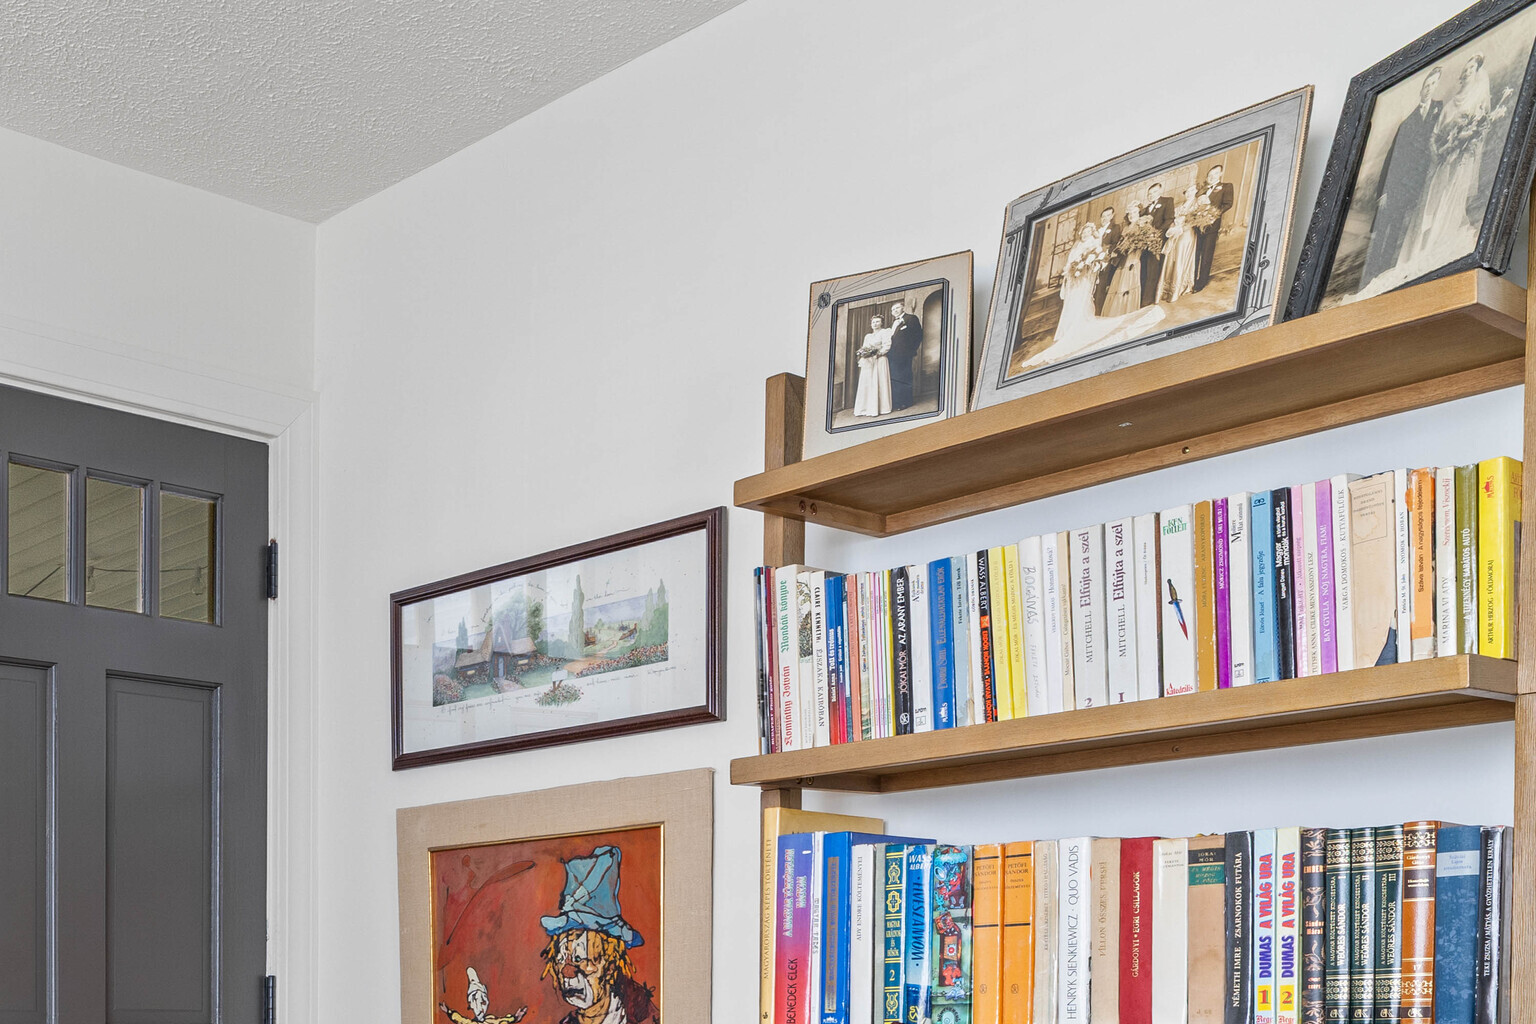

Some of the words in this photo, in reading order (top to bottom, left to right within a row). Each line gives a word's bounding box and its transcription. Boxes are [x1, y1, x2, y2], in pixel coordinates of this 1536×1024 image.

[1441, 477, 1451, 507] Viszockij
[1078, 532, 1090, 554] szél
[1111, 523, 1123, 546] szél
[1319, 524, 1327, 545] FIAM!
[1083, 556, 1090, 564] a
[1275, 542, 1284, 567] Magyar
[1281, 536, 1290, 566] mondák
[1340, 548, 1348, 584] DOMOKOS
[896, 577, 905, 603] EMBER
[1079, 567, 1092, 608] Elfújta
[1112, 560, 1126, 601] Elfújta
[979, 582, 988, 610] ALBERT
[897, 605, 906, 631] ARANY
[1322, 601, 1330, 626] GYULA
[1442, 608, 1450, 644] MARINA
[897, 633, 906, 645] AZ
[1085, 611, 1093, 662] MITCHELL
[1117, 604, 1126, 657] MITCHELL
[1323, 629, 1331, 642] BAY
[898, 650, 907, 668] MÓR
[899, 669, 908, 694] JÓKAI
[1084, 697, 1092, 707] 2
[1069, 845, 1078, 876] VADIS
[1233, 852, 1242, 884] FUTÁRA
[1259, 852, 1272, 880] URA
[1282, 851, 1295, 879] URA
[1132, 871, 1140, 913] CSILLAGOK
[1388, 873, 1396, 881] III
[1068, 880, 1079, 905] QUO
[1256, 881, 1272, 918] VILÁG
[1278, 881, 1295, 917] VILÁG
[1132, 916, 1140, 933] EGRI
[1234, 886, 1242, 938] ZSARNOKOK
[1259, 919, 1272, 929] A
[1282, 918, 1295, 928] A
[1336, 903, 1345, 935] SÁNDOR
[1360, 903, 1369, 934] SÁNDOR
[1386, 901, 1396, 933] SÁNDOR
[1067, 914, 1078, 977] SIENKIEWICZ
[1131, 940, 1139, 977] GÁRDONYI
[1233, 947, 1241, 969] IMRE
[1259, 935, 1272, 978] DUMAS
[1281, 935, 1294, 978] DUMAS
[1337, 935, 1345, 966] WEÖRES
[1361, 934, 1369, 966] WEÖRES
[1387, 934, 1395, 965] WEÖRES
[788, 959, 798, 980] ELEK
[889, 969, 895, 982] 2
[786, 983, 797, 1024] BENEDEK
[1067, 979, 1077, 1019] HENRYK
[1232, 972, 1240, 1007] NÉMETH
[1260, 989, 1269, 1004] 1
[1282, 991, 1292, 1004] 2
